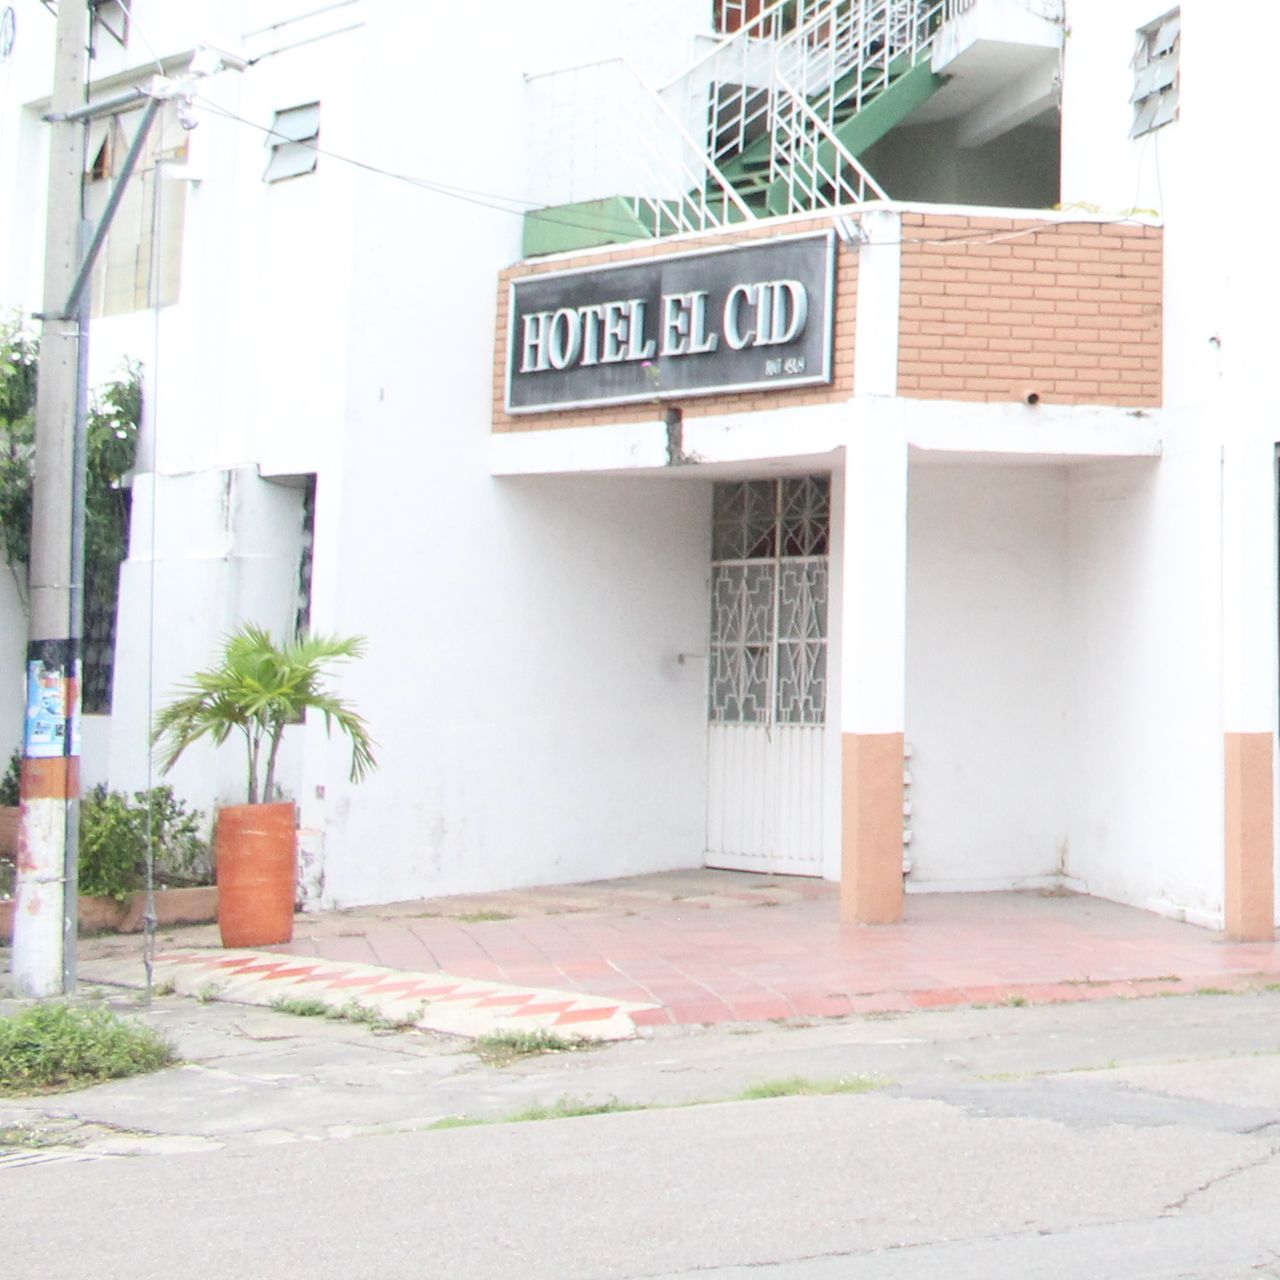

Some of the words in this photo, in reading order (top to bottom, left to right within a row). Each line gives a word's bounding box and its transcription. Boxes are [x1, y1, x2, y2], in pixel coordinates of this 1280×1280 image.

[520, 299, 655, 373] HOTEL
[660, 291, 717, 357] EL
[724, 279, 808, 350] CID
